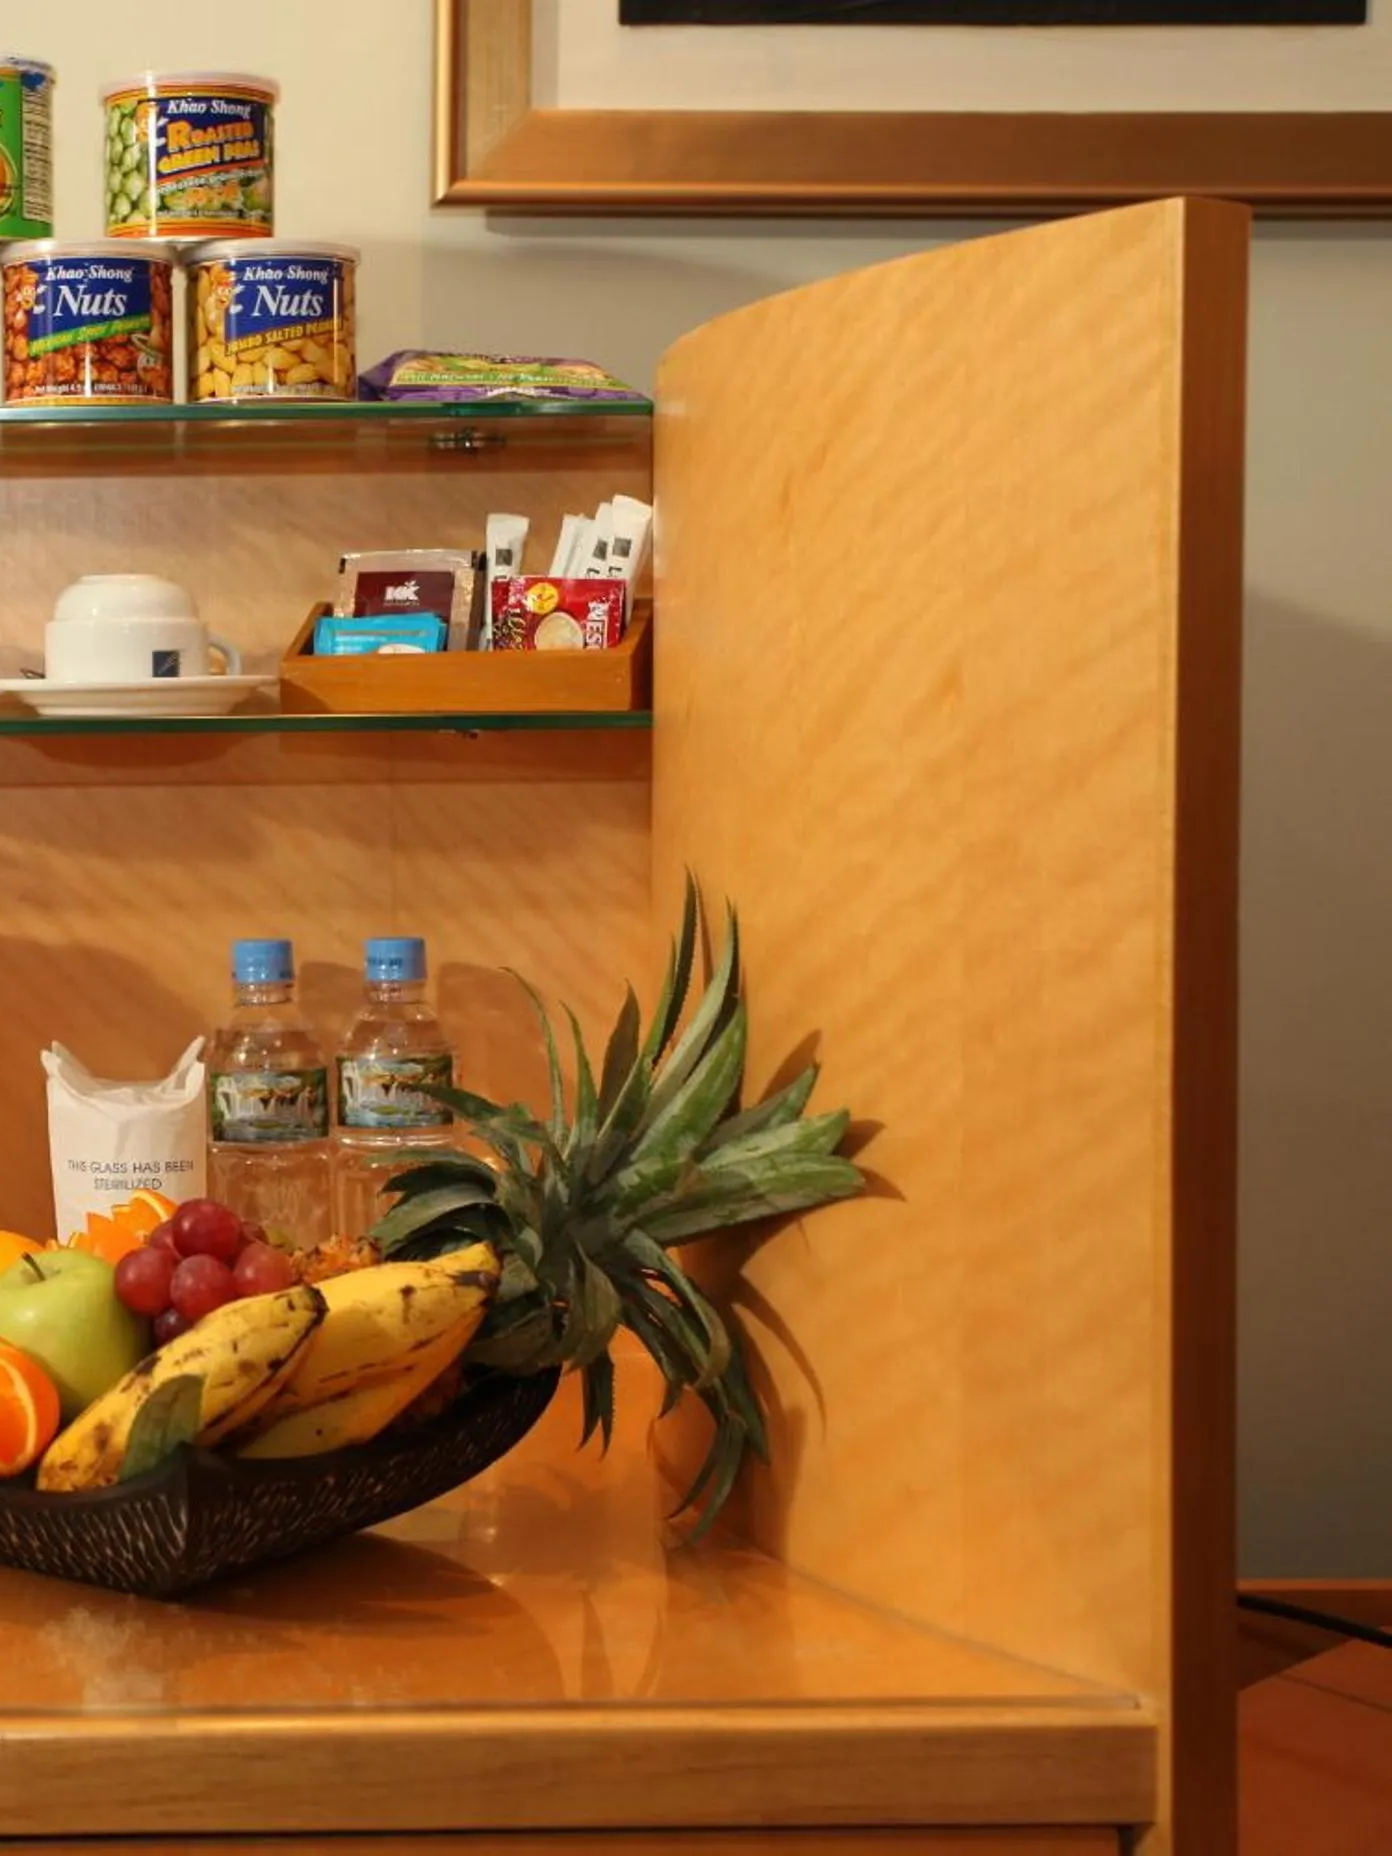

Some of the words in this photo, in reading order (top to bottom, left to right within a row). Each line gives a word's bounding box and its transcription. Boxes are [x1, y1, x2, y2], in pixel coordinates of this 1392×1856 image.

[167, 100, 207, 114] Khao
[211, 100, 251, 118] Shong
[46, 265, 83, 281] Khao
[88, 265, 133, 282] Shong
[243, 266, 283, 281] Khao
[286, 265, 329, 285] Shong
[53, 285, 127, 317] Nuts
[251, 285, 324, 317] Nuts
[266, 325, 304, 344] SALTED
[68, 1160, 87, 1172] THIS
[90, 1161, 127, 1173] GLASS
[133, 1161, 161, 1173] HAS
[165, 1160, 194, 1173] BEEN
[94, 1178, 162, 1191] STERILIZED
